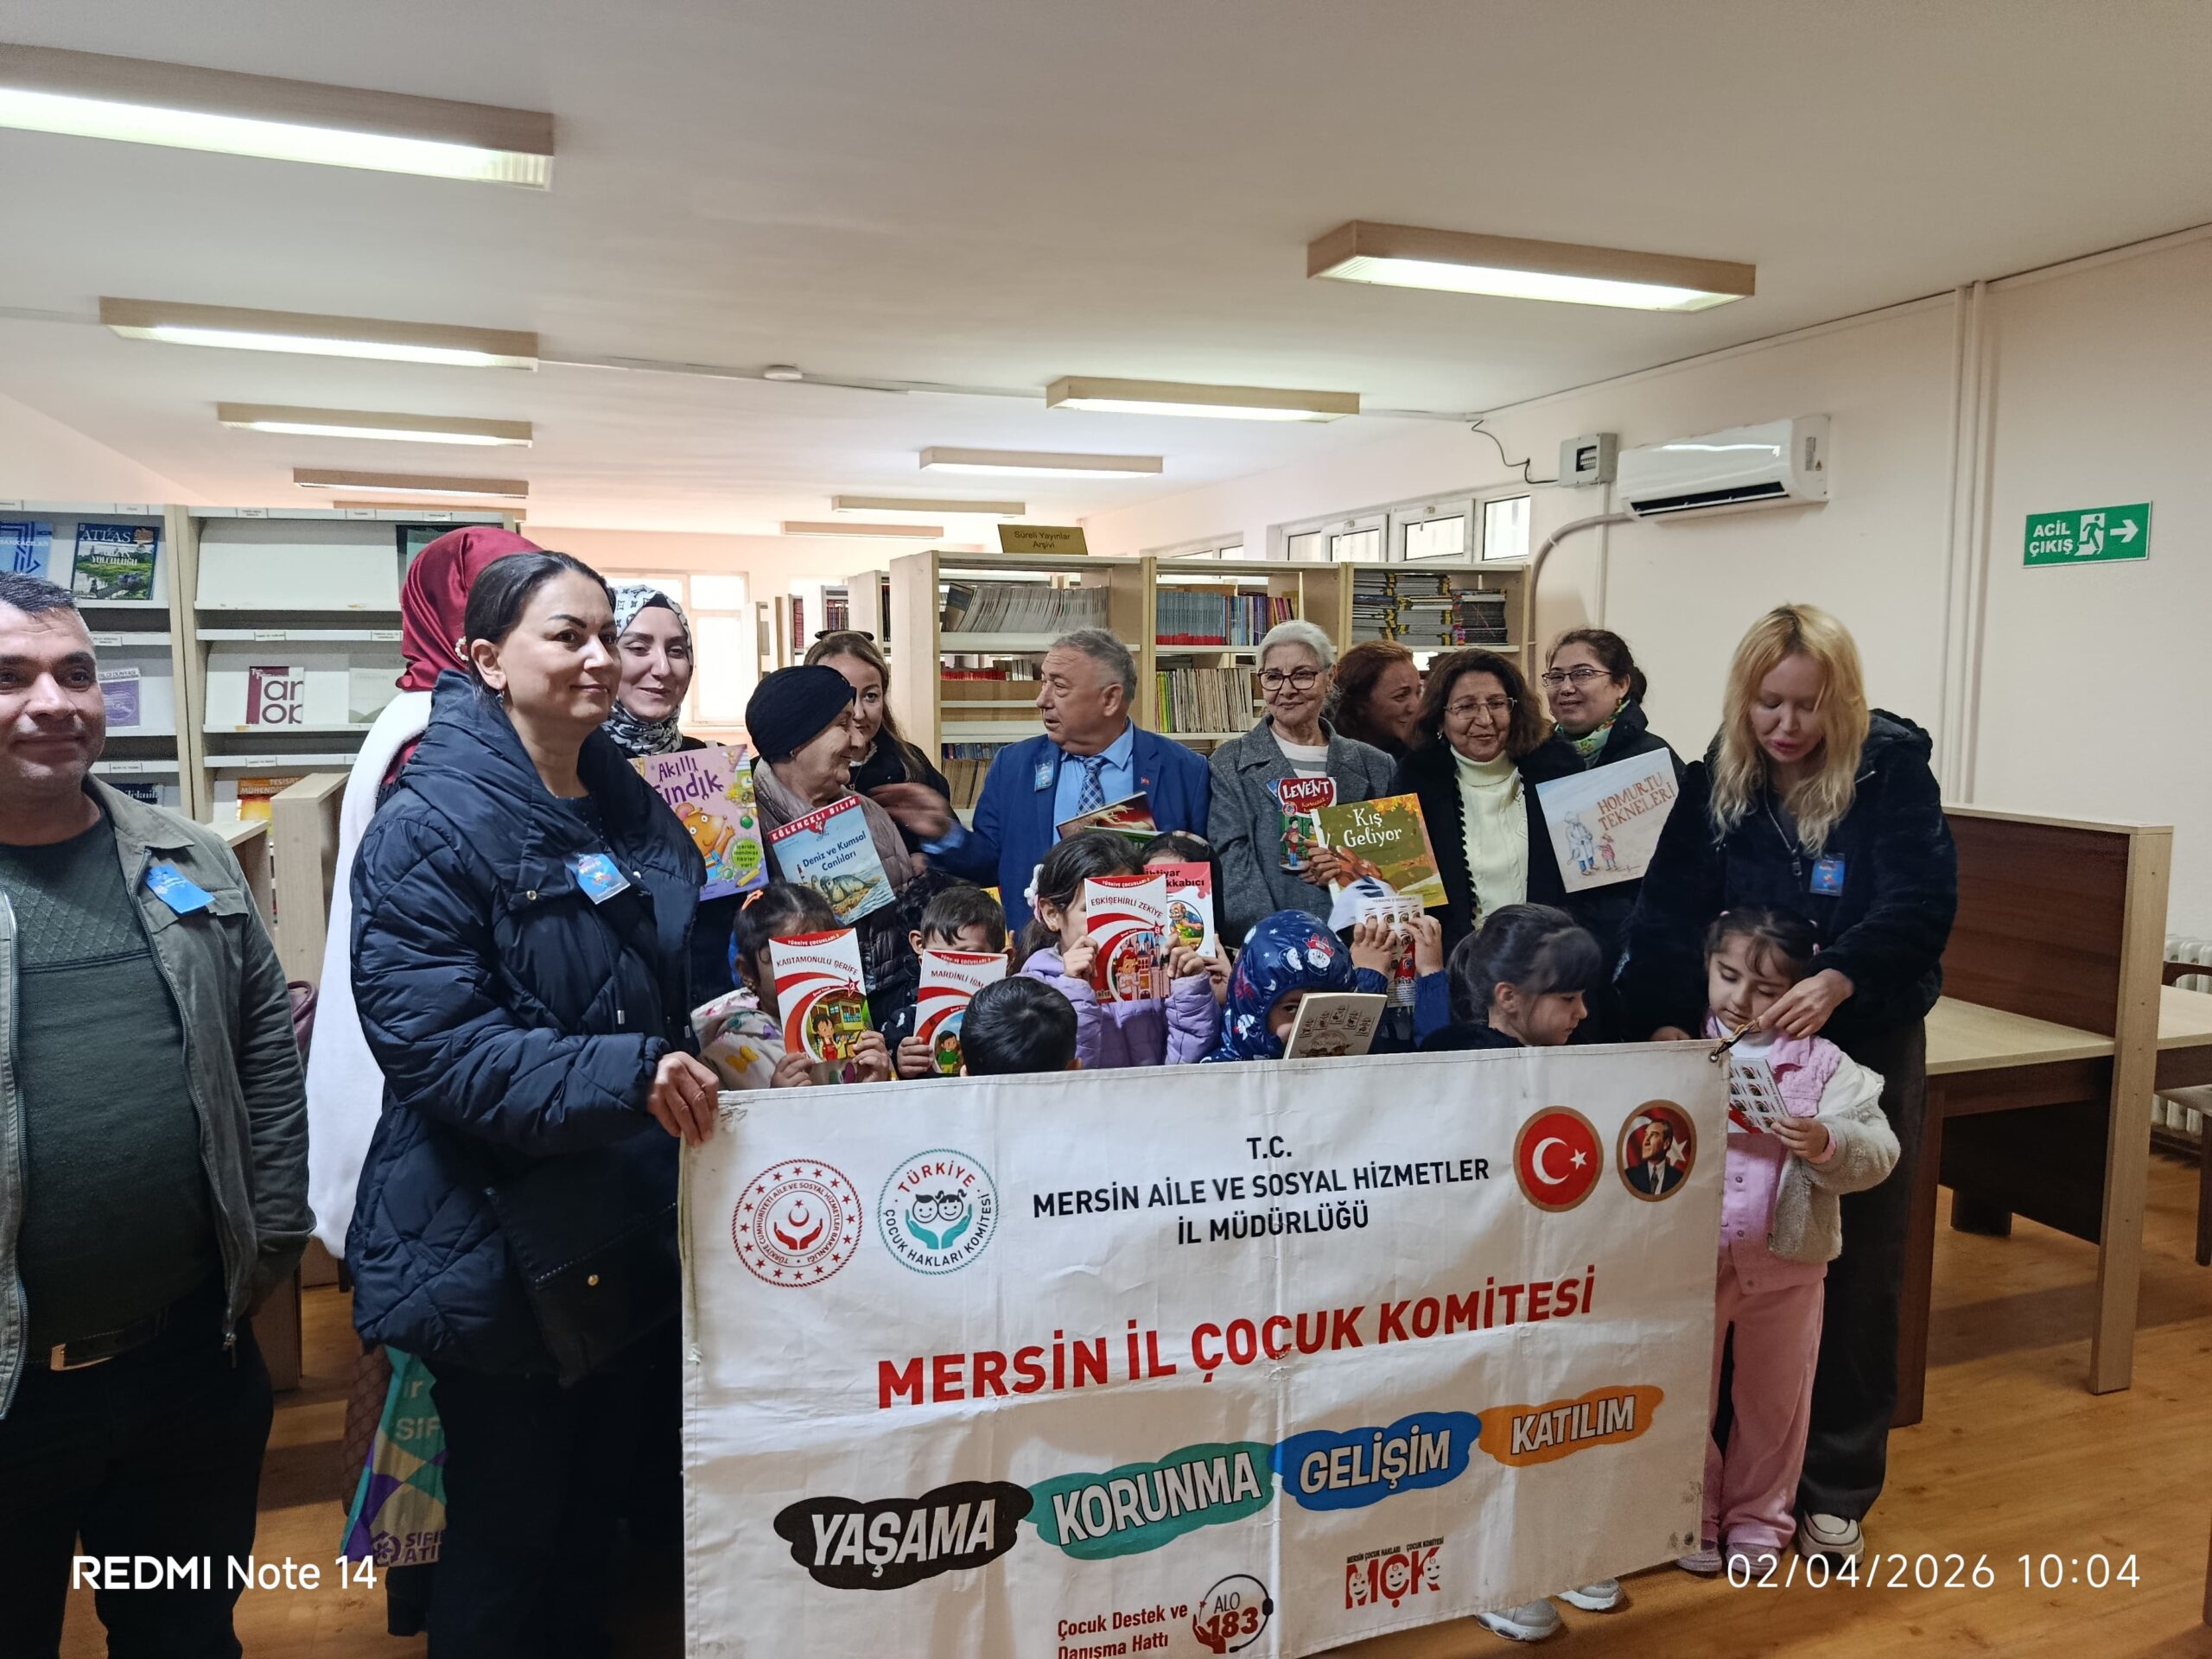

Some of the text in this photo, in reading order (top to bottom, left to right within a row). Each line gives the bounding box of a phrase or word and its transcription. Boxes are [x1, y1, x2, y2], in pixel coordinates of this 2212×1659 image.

[79, 529, 130, 542] ATLAS
[1039, 532, 1071, 541] Yayınlar
[2033, 520, 2071, 537] ACİL
[2029, 538, 2074, 557] ÇIKIŞ
[658, 755, 698, 782] Akıllı
[1283, 780, 1330, 799] LEVENT
[1597, 772, 1663, 815] HOMURTU
[1352, 808, 1382, 827] Kış
[1599, 782, 1675, 831] TEKNELERİ
[1344, 826, 1402, 847] Geliyor
[803, 831, 866, 868] Deniz ve Kumsal
[823, 851, 856, 871] Canlıları
[1166, 879, 1205, 887] kkabıcı
[1090, 895, 1163, 919] ESKİŞEHİRLİ ZEKİYE
[777, 956, 859, 976] KASTAMONULU ŞERİFE
[931, 969, 969, 982] MARDİNLİ
[849, 982, 855, 990] 2
[1247, 1136, 1293, 1160] T.C.
[898, 1160, 976, 1192] TÜRKİYE
[1033, 1158, 1491, 1218] MERSİN AİLE VE SOSYAL HİZMETLER
[774, 1185, 788, 1198] AİLE
[799, 1182, 824, 1196] SOSYAL
[756, 1197, 774, 1244] CUMHURİYETİ
[823, 1193, 841, 1233] HİZMETLER
[1178, 1200, 1369, 1245] İL MÜDÜRLÜĞÜ
[883, 1192, 992, 1267] ÇOCUK HAKLARI KOMİTESİ
[763, 1243, 788, 1264] TÜRKİYE
[807, 1232, 838, 1263] BAKANLIĞI
[878, 1264, 1595, 1409] MERSİN İL ÇOCUK KOMİTESİ
[810, 1395, 1636, 1578] YAŞAMA KORUNMA GELİŞİM KATILIM
[1346, 1535, 1444, 1563] MERSİN ÇOCUK HAKLARI ÇOCUK KOMİTESİ
[1345, 1546, 1441, 1610] MÇK
[1213, 1592, 1241, 1614] ALO
[1058, 1604, 1188, 1641] Çocuk Destek ve
[1205, 1606, 1258, 1641] 183
[1058, 1632, 1168, 1659] Danışma Hattı
